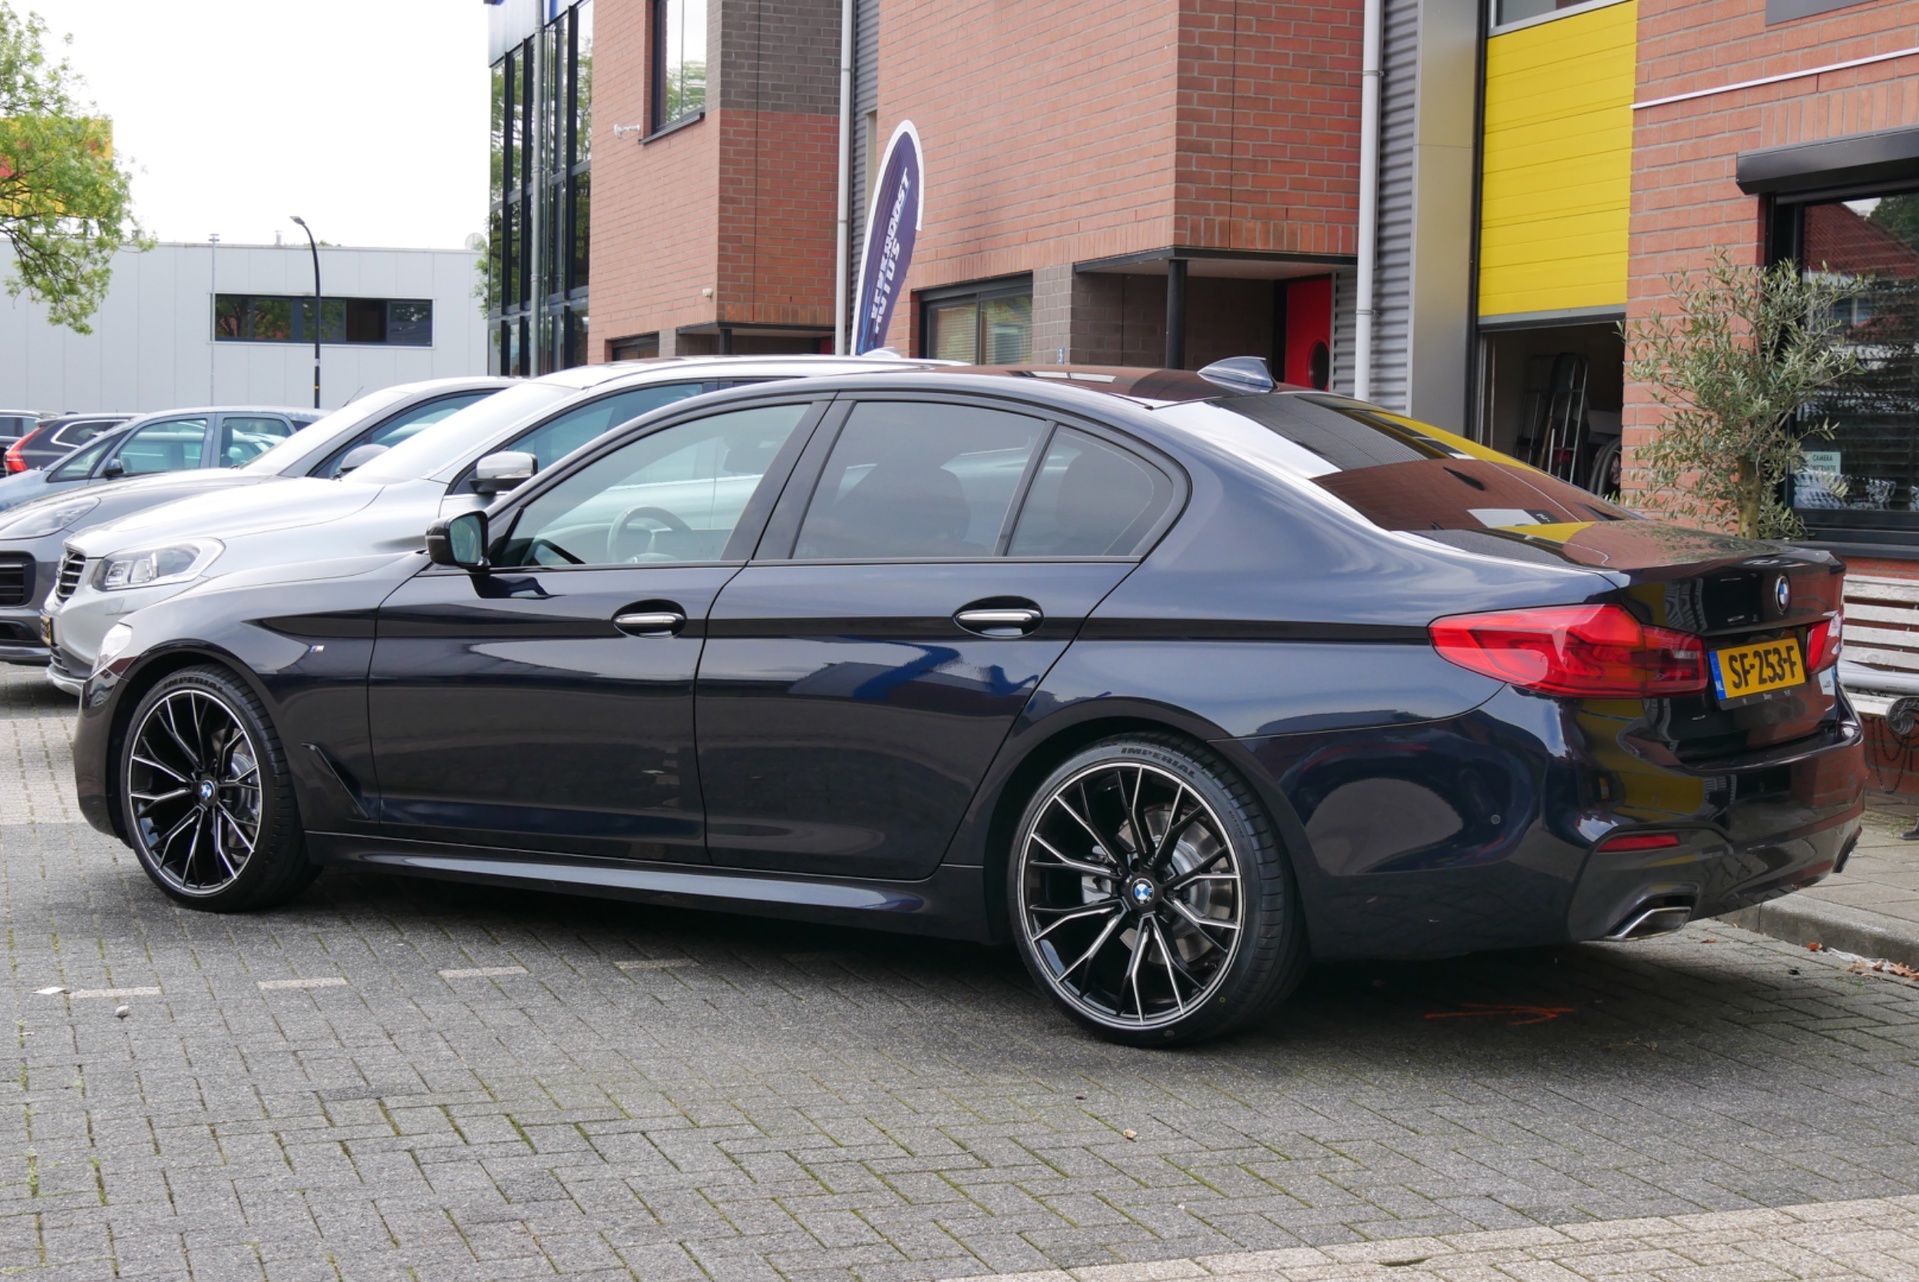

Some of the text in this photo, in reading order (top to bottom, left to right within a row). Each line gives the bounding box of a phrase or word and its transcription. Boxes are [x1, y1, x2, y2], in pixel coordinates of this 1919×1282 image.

[1812, 454, 1833, 462] CAMERA
[1728, 645, 1798, 690] SF-253-F
[1121, 747, 1195, 779] IMPERIAL
